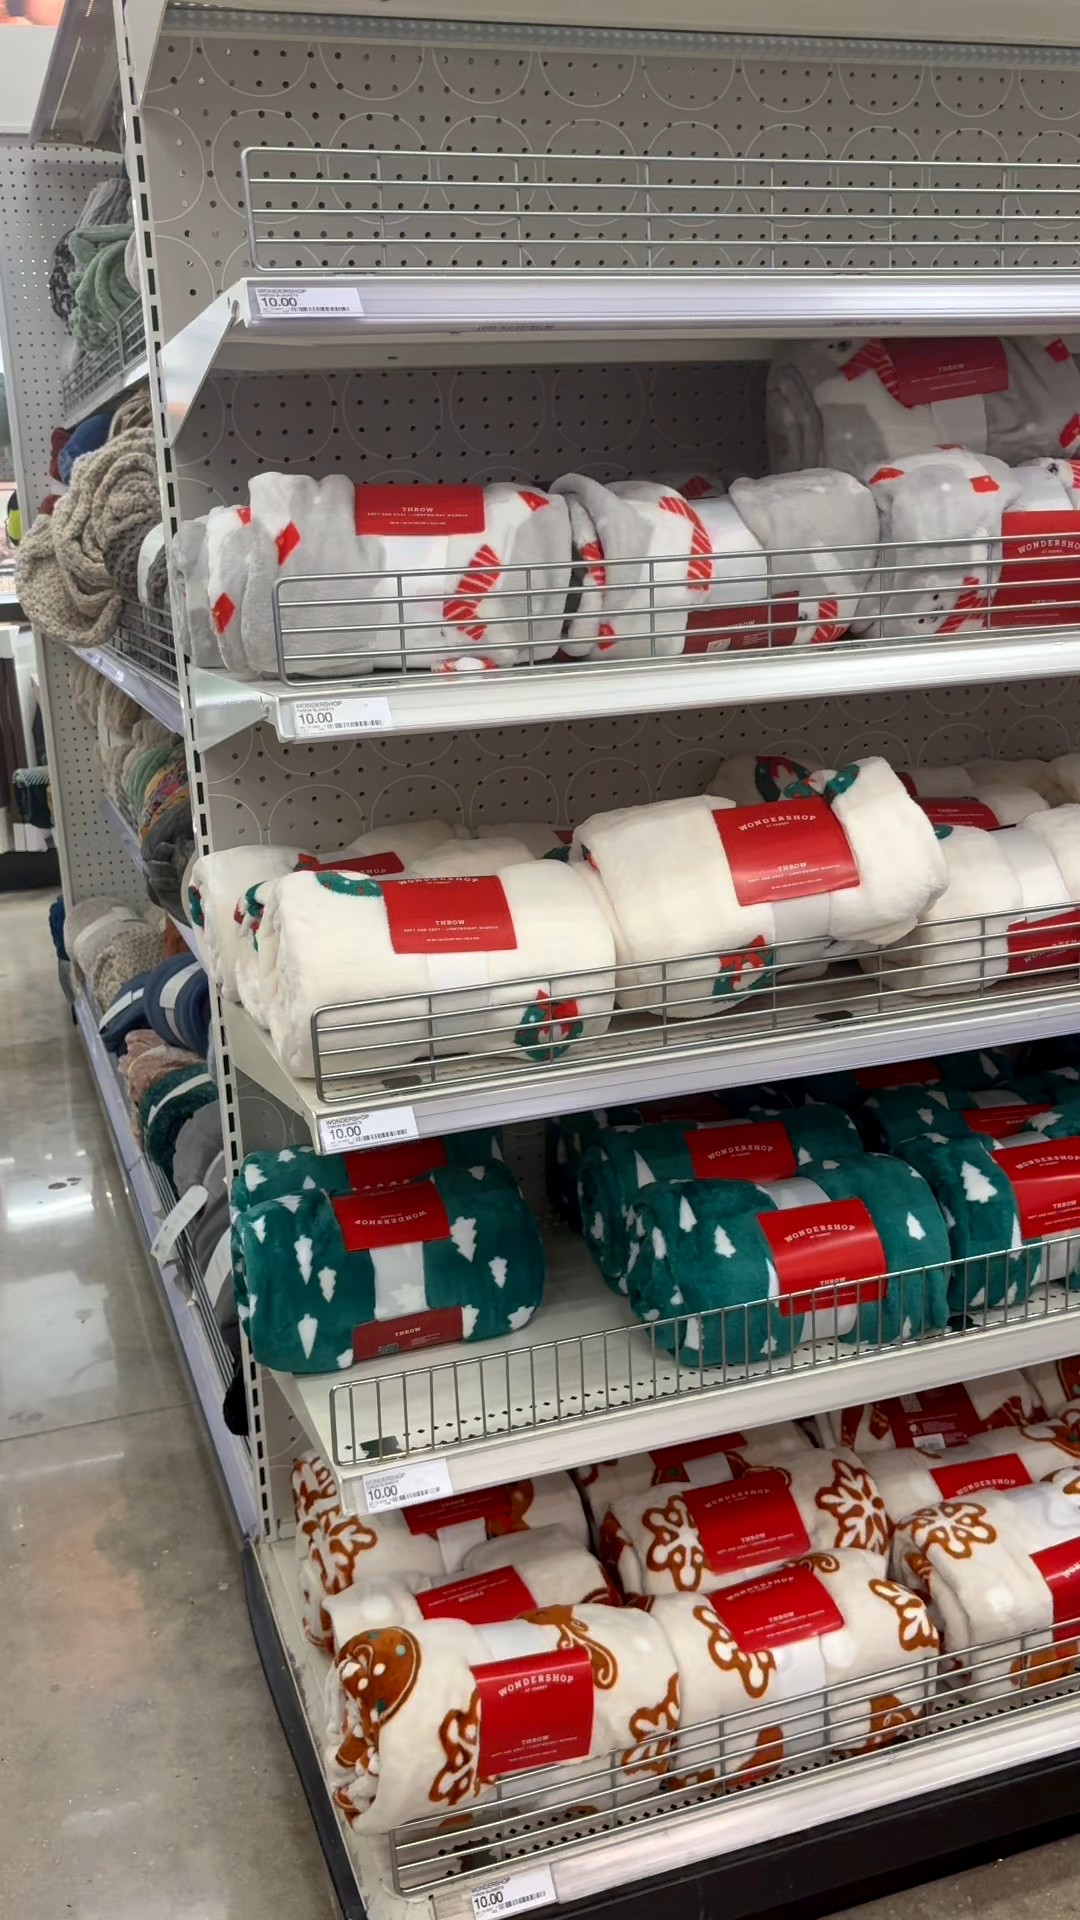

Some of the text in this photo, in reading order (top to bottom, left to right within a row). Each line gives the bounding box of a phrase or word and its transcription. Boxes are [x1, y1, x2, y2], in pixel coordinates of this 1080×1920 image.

[261, 297, 298, 307] 10.00
[1017, 539, 1080, 554] WONDERSHO
[296, 700, 343, 709] WONDERSHOP
[298, 712, 333, 725] 10.00
[738, 814, 817, 831] WONDERSHOP
[777, 862, 807, 872] THROW
[326, 1114, 370, 1125] WONDERSHOP
[329, 1125, 362, 1140] 10.00
[707, 1144, 774, 1160] WONDERSHOP
[1014, 1154, 1080, 1170] WONDERSHOP
[1052, 1200, 1077, 1209] THROW
[354, 1210, 428, 1226] WONDERSHOP
[784, 1223, 856, 1243] WONDERSHOP
[819, 1276, 846, 1286] THROW
[394, 1326, 421, 1337] THROW
[368, 1484, 398, 1501] 10.00
[956, 1478, 1016, 1496] WONDERSHOP
[704, 1488, 770, 1509] WONDERSHOP
[740, 1532, 766, 1544] THROW
[725, 1576, 795, 1601] WONDERSHOP
[768, 1611, 795, 1623] THROW
[498, 1673, 574, 1697] WONDERSHOP
[521, 1734, 550, 1745] THROW
[472, 1876, 511, 1893] WONDERSHOP
[474, 1891, 504, 1909] 10.00
